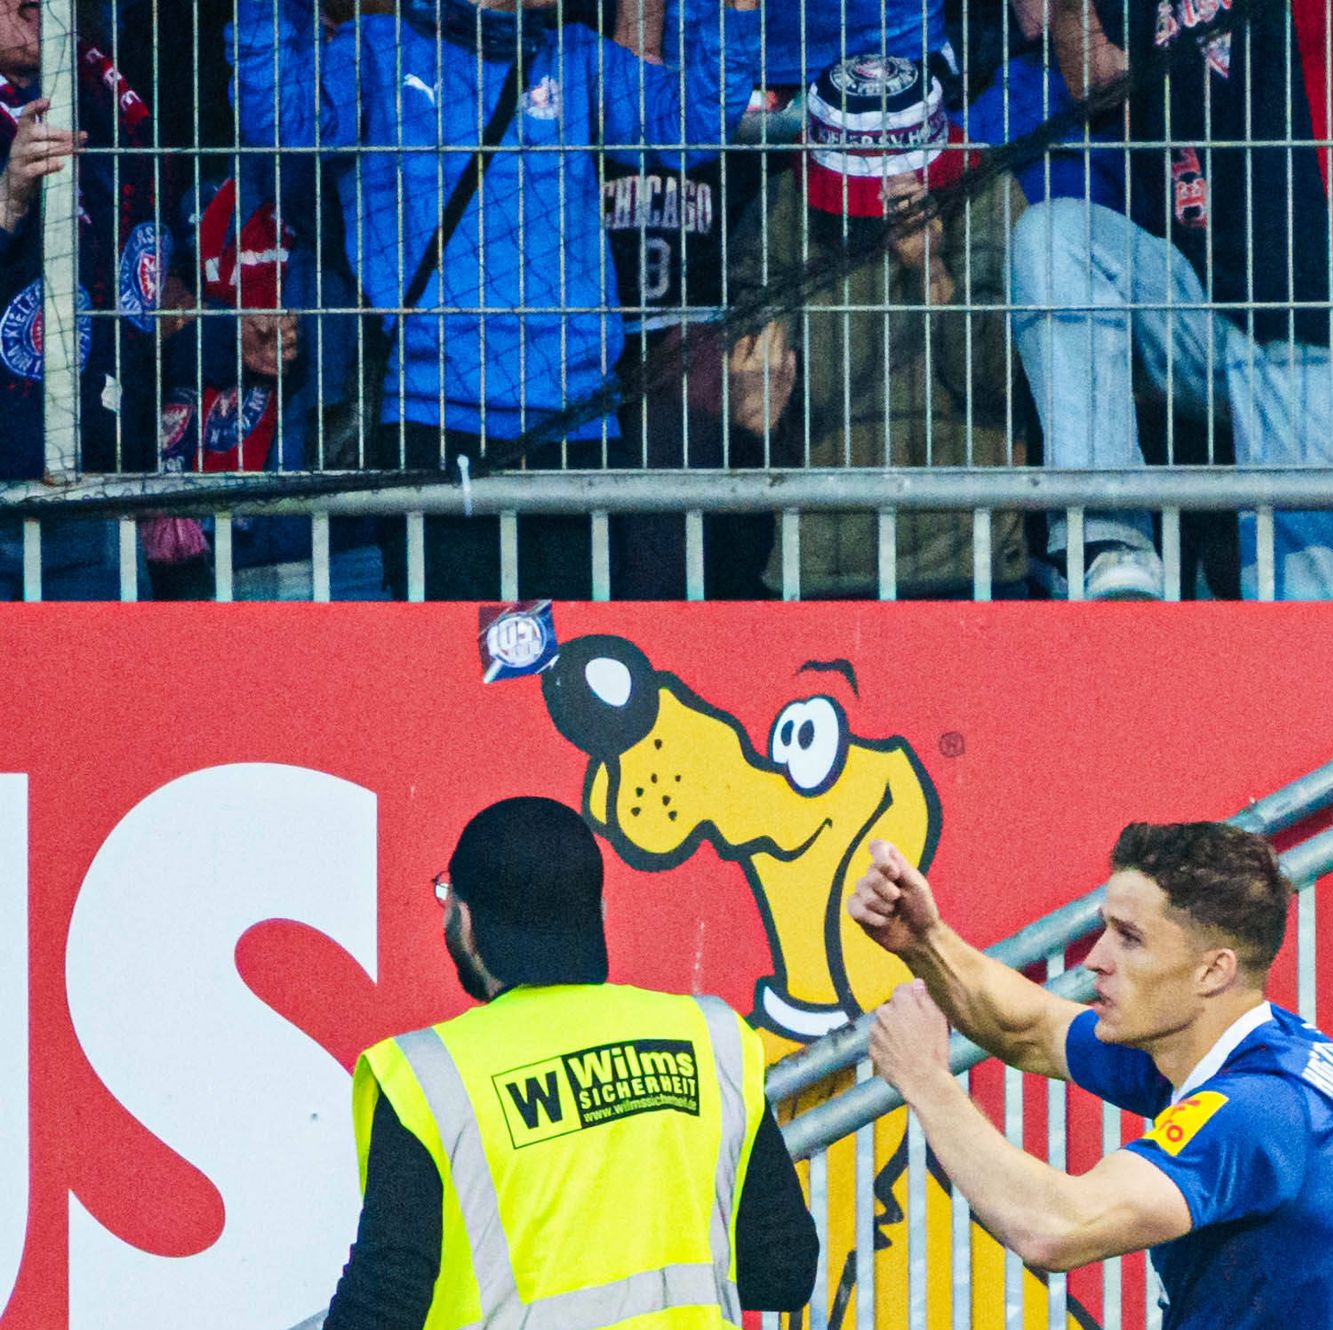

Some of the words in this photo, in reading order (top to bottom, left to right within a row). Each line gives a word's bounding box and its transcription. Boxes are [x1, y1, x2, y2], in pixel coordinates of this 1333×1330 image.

[601, 175, 713, 234] CHICAGO
[566, 1045, 695, 1090] Wilms
[578, 1075, 696, 1110] SICHERHEIT
[505, 1070, 563, 1130] W
